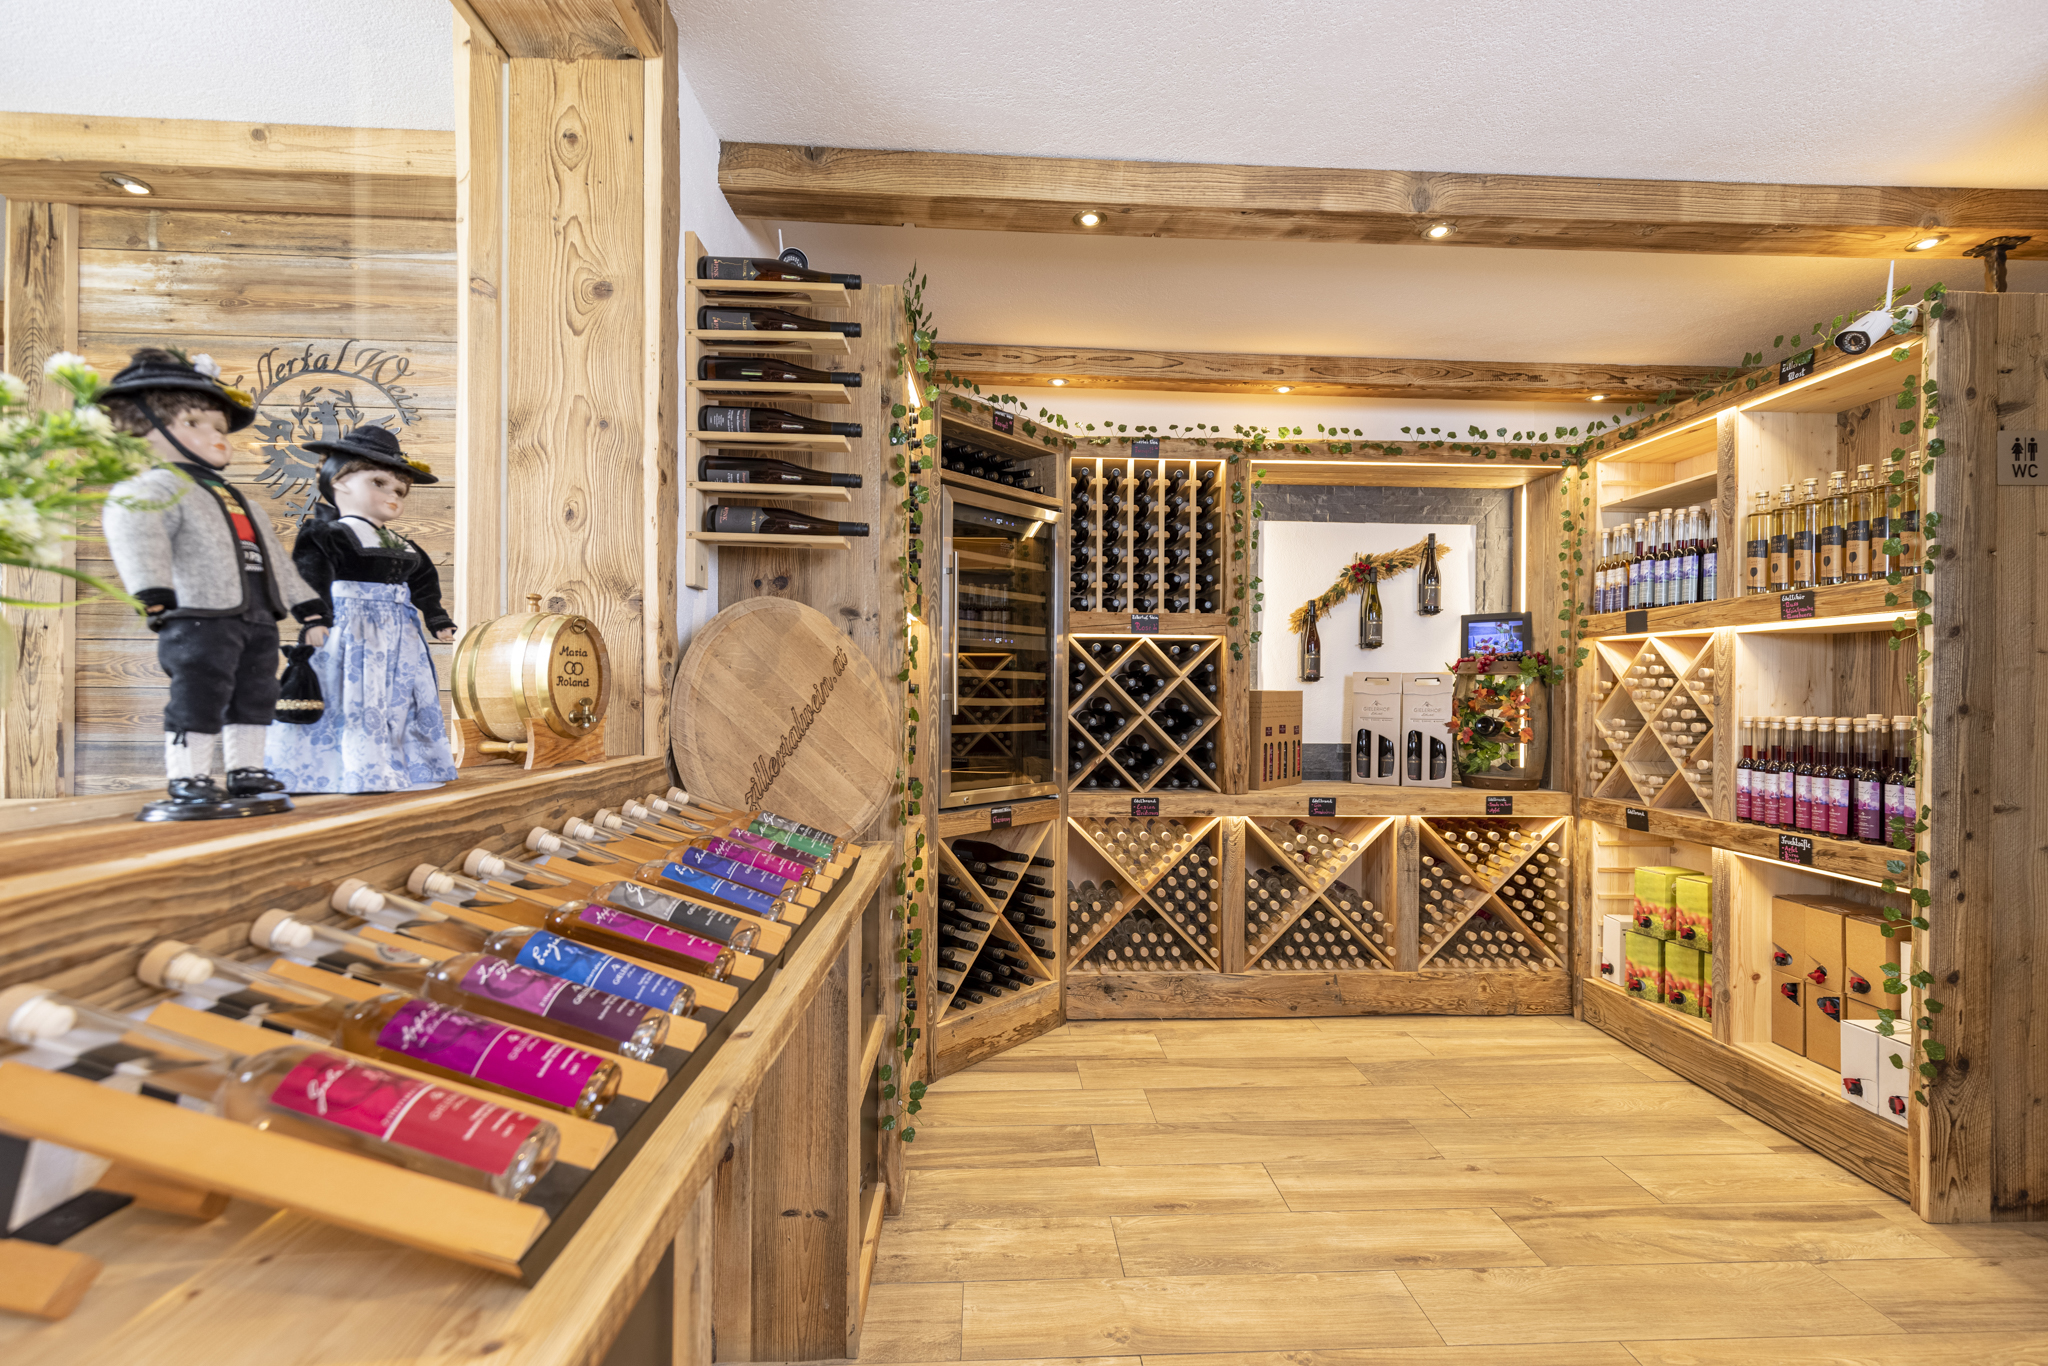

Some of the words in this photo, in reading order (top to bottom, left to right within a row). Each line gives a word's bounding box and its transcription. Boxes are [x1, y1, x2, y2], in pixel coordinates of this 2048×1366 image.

[355, 348, 422, 426] Wein
[2012, 464, 2038, 478] WC
[559, 645, 588, 657] Maria
[556, 676, 590, 688] Roland
